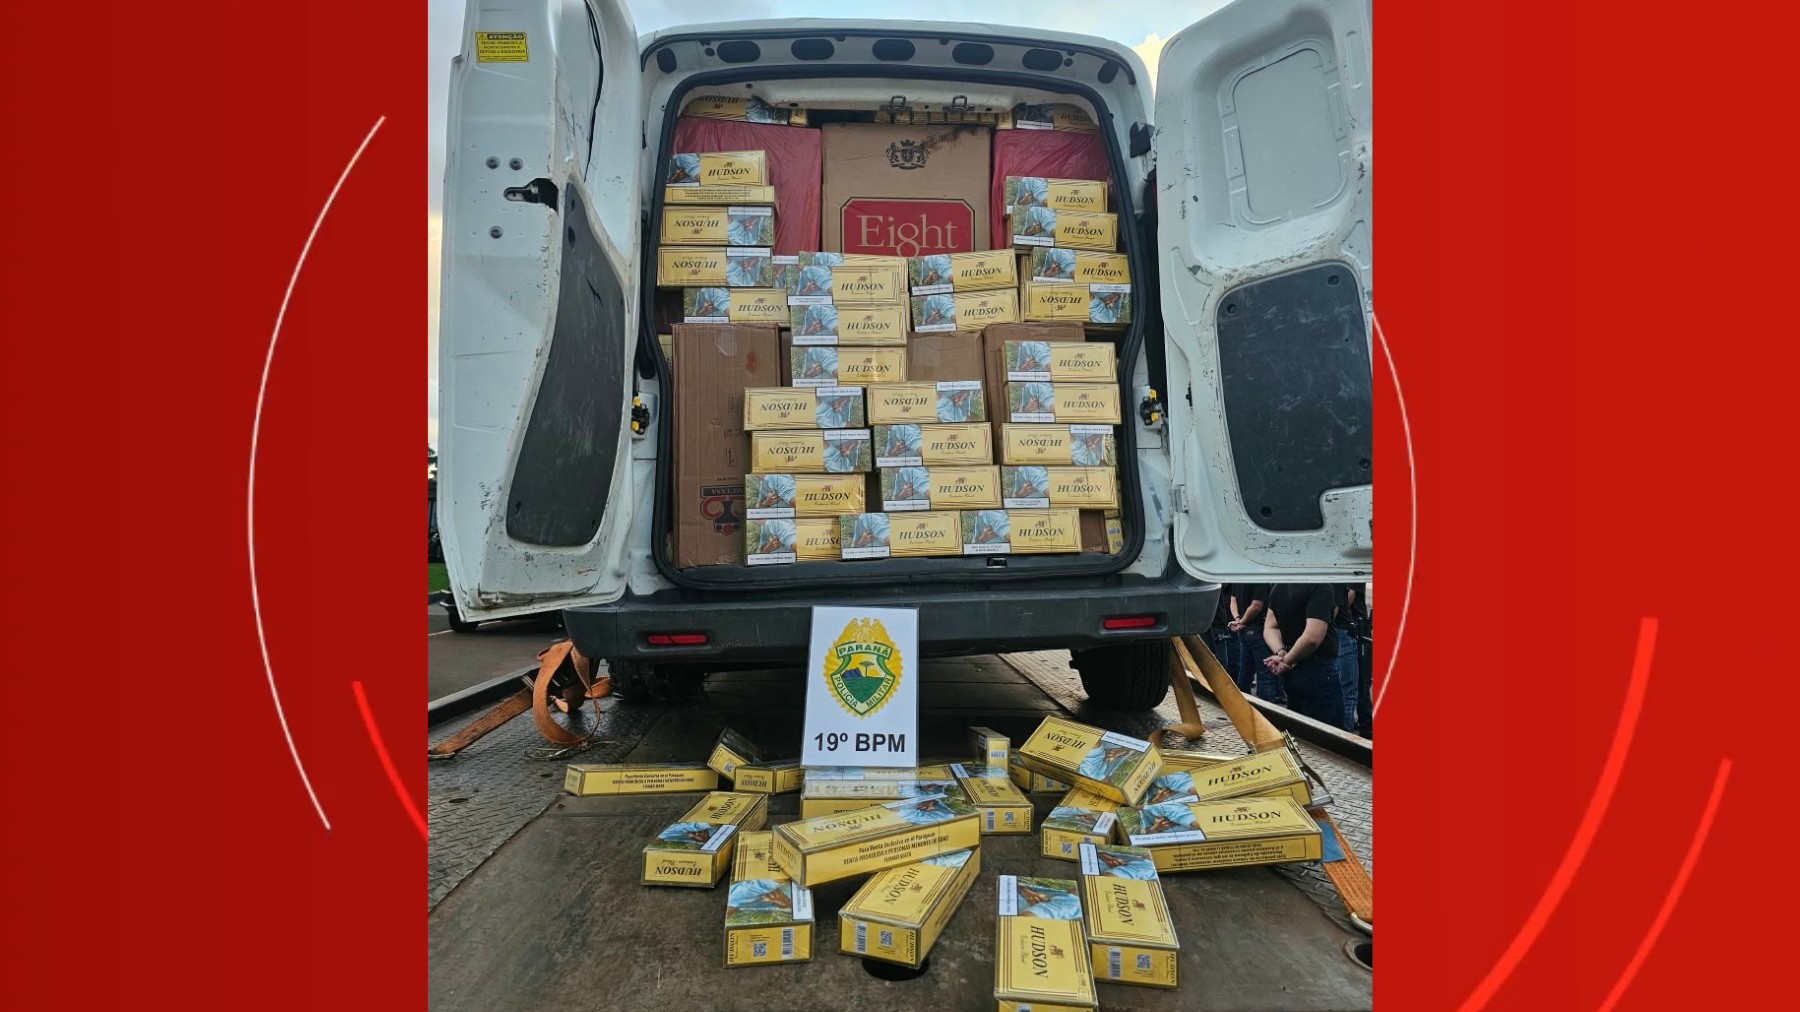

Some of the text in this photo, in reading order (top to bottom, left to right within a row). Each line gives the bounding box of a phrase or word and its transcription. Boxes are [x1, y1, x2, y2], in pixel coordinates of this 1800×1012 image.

[708, 168, 751, 176] HUDSON
[1055, 196, 1095, 204] HUDSON
[856, 212, 960, 258] Eight
[1064, 226, 1104, 236] HUDSON
[961, 267, 1002, 278] HUDSON
[1083, 268, 1124, 277] HUDSON
[841, 283, 884, 291] HUDSON
[964, 306, 1006, 317] HUDSON
[846, 364, 892, 373] HUDSON
[760, 402, 807, 410] HUDSON
[883, 398, 928, 406] HUDSON
[931, 442, 976, 450] HUDSON
[939, 484, 984, 493] HUDSON
[1057, 484, 1102, 492] HUDSON
[804, 492, 851, 500] HUDSON
[900, 530, 946, 540] HUDSON
[1018, 528, 1065, 537] HUDSON
[838, 644, 889, 656] PARANÁ
[866, 677, 892, 708] MILITAR
[814, 732, 906, 752] 19º BPM
[1044, 732, 1086, 750] HUDSON
[1133, 761, 1156, 794] HUDSON
[1208, 764, 1273, 786] HUDSON
[710, 796, 738, 820] HUDSON
[1212, 810, 1282, 824] HUDSON
[813, 814, 882, 833] HUDSON
[884, 839, 904, 848] Exclusiva
[912, 840, 932, 849] MENORES
[656, 866, 702, 876] HUDSON
[884, 868, 920, 906] HUDSON
[1112, 882, 1134, 926] HUDSON
[1030, 925, 1048, 979] HUDSON
